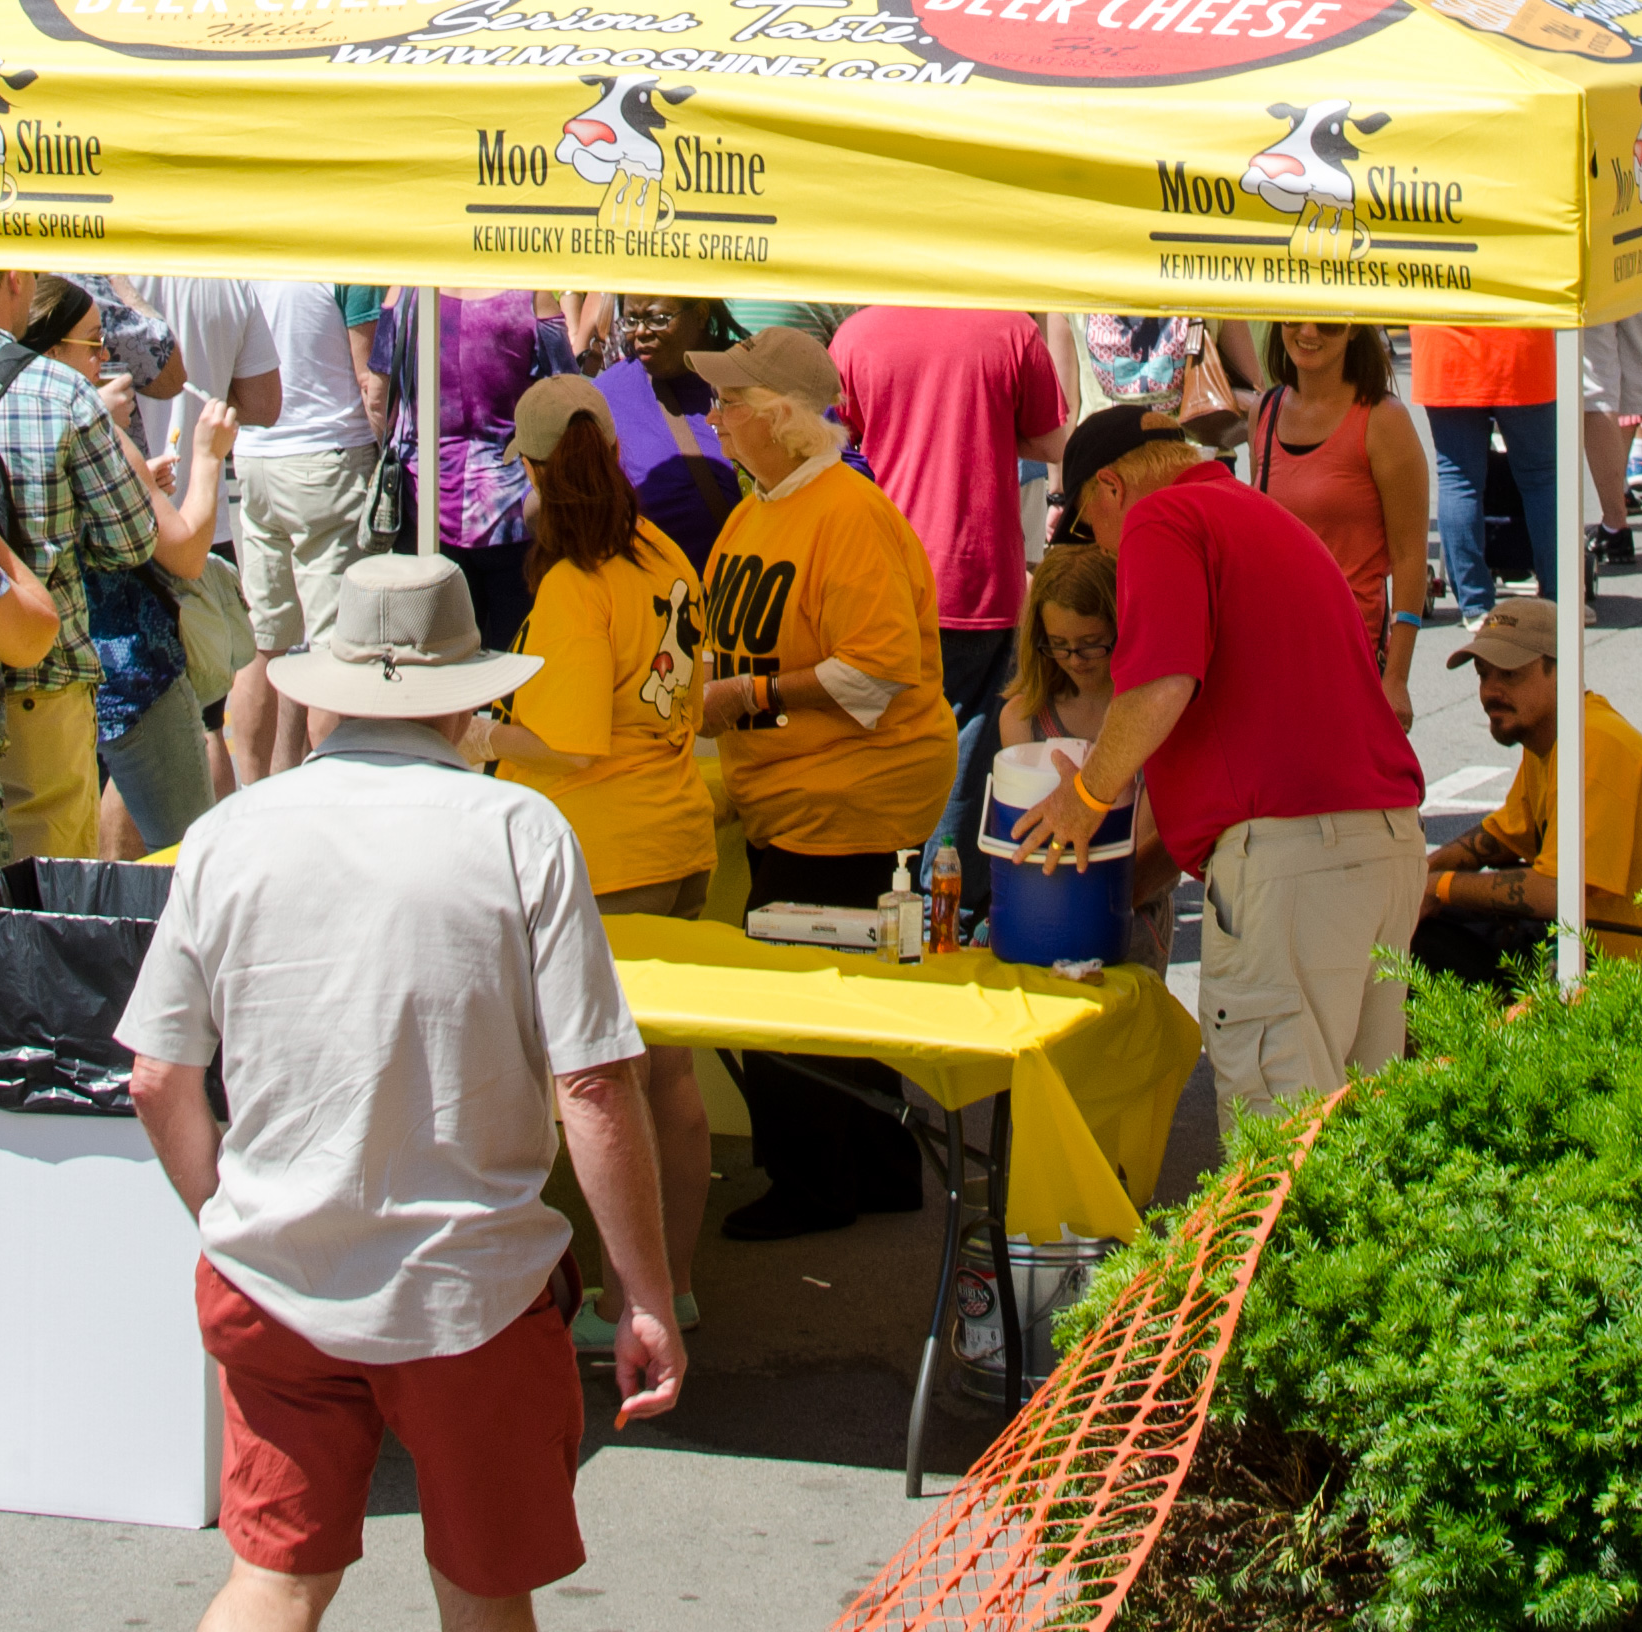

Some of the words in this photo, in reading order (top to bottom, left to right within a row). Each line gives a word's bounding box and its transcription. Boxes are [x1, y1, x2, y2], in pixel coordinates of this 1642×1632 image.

[206, 20, 335, 39] Mild
[1050, 35, 1143, 58] Hot
[332, 43, 976, 86] WWW.MOOSHINE.COM
[16, 119, 103, 176] Shine
[477, 129, 548, 186] Moo
[674, 135, 766, 196] Shine
[1155, 159, 1236, 215] Moo
[1367, 165, 1463, 225] Shine
[1611, 157, 1634, 216] Moo
[38, 213, 106, 240] SPREAD
[473, 225, 565, 254] KENTUCKY
[571, 227, 616, 256] BEER
[625, 230, 691, 258] CHEESE
[698, 233, 769, 263] SPREAD
[1159, 253, 1256, 283] KENTUCKY
[1263, 256, 1310, 285] BEER
[1320, 258, 1391, 287] CHEESE
[1398, 261, 1472, 290] SPREAD
[706, 552, 797, 655] MOO
